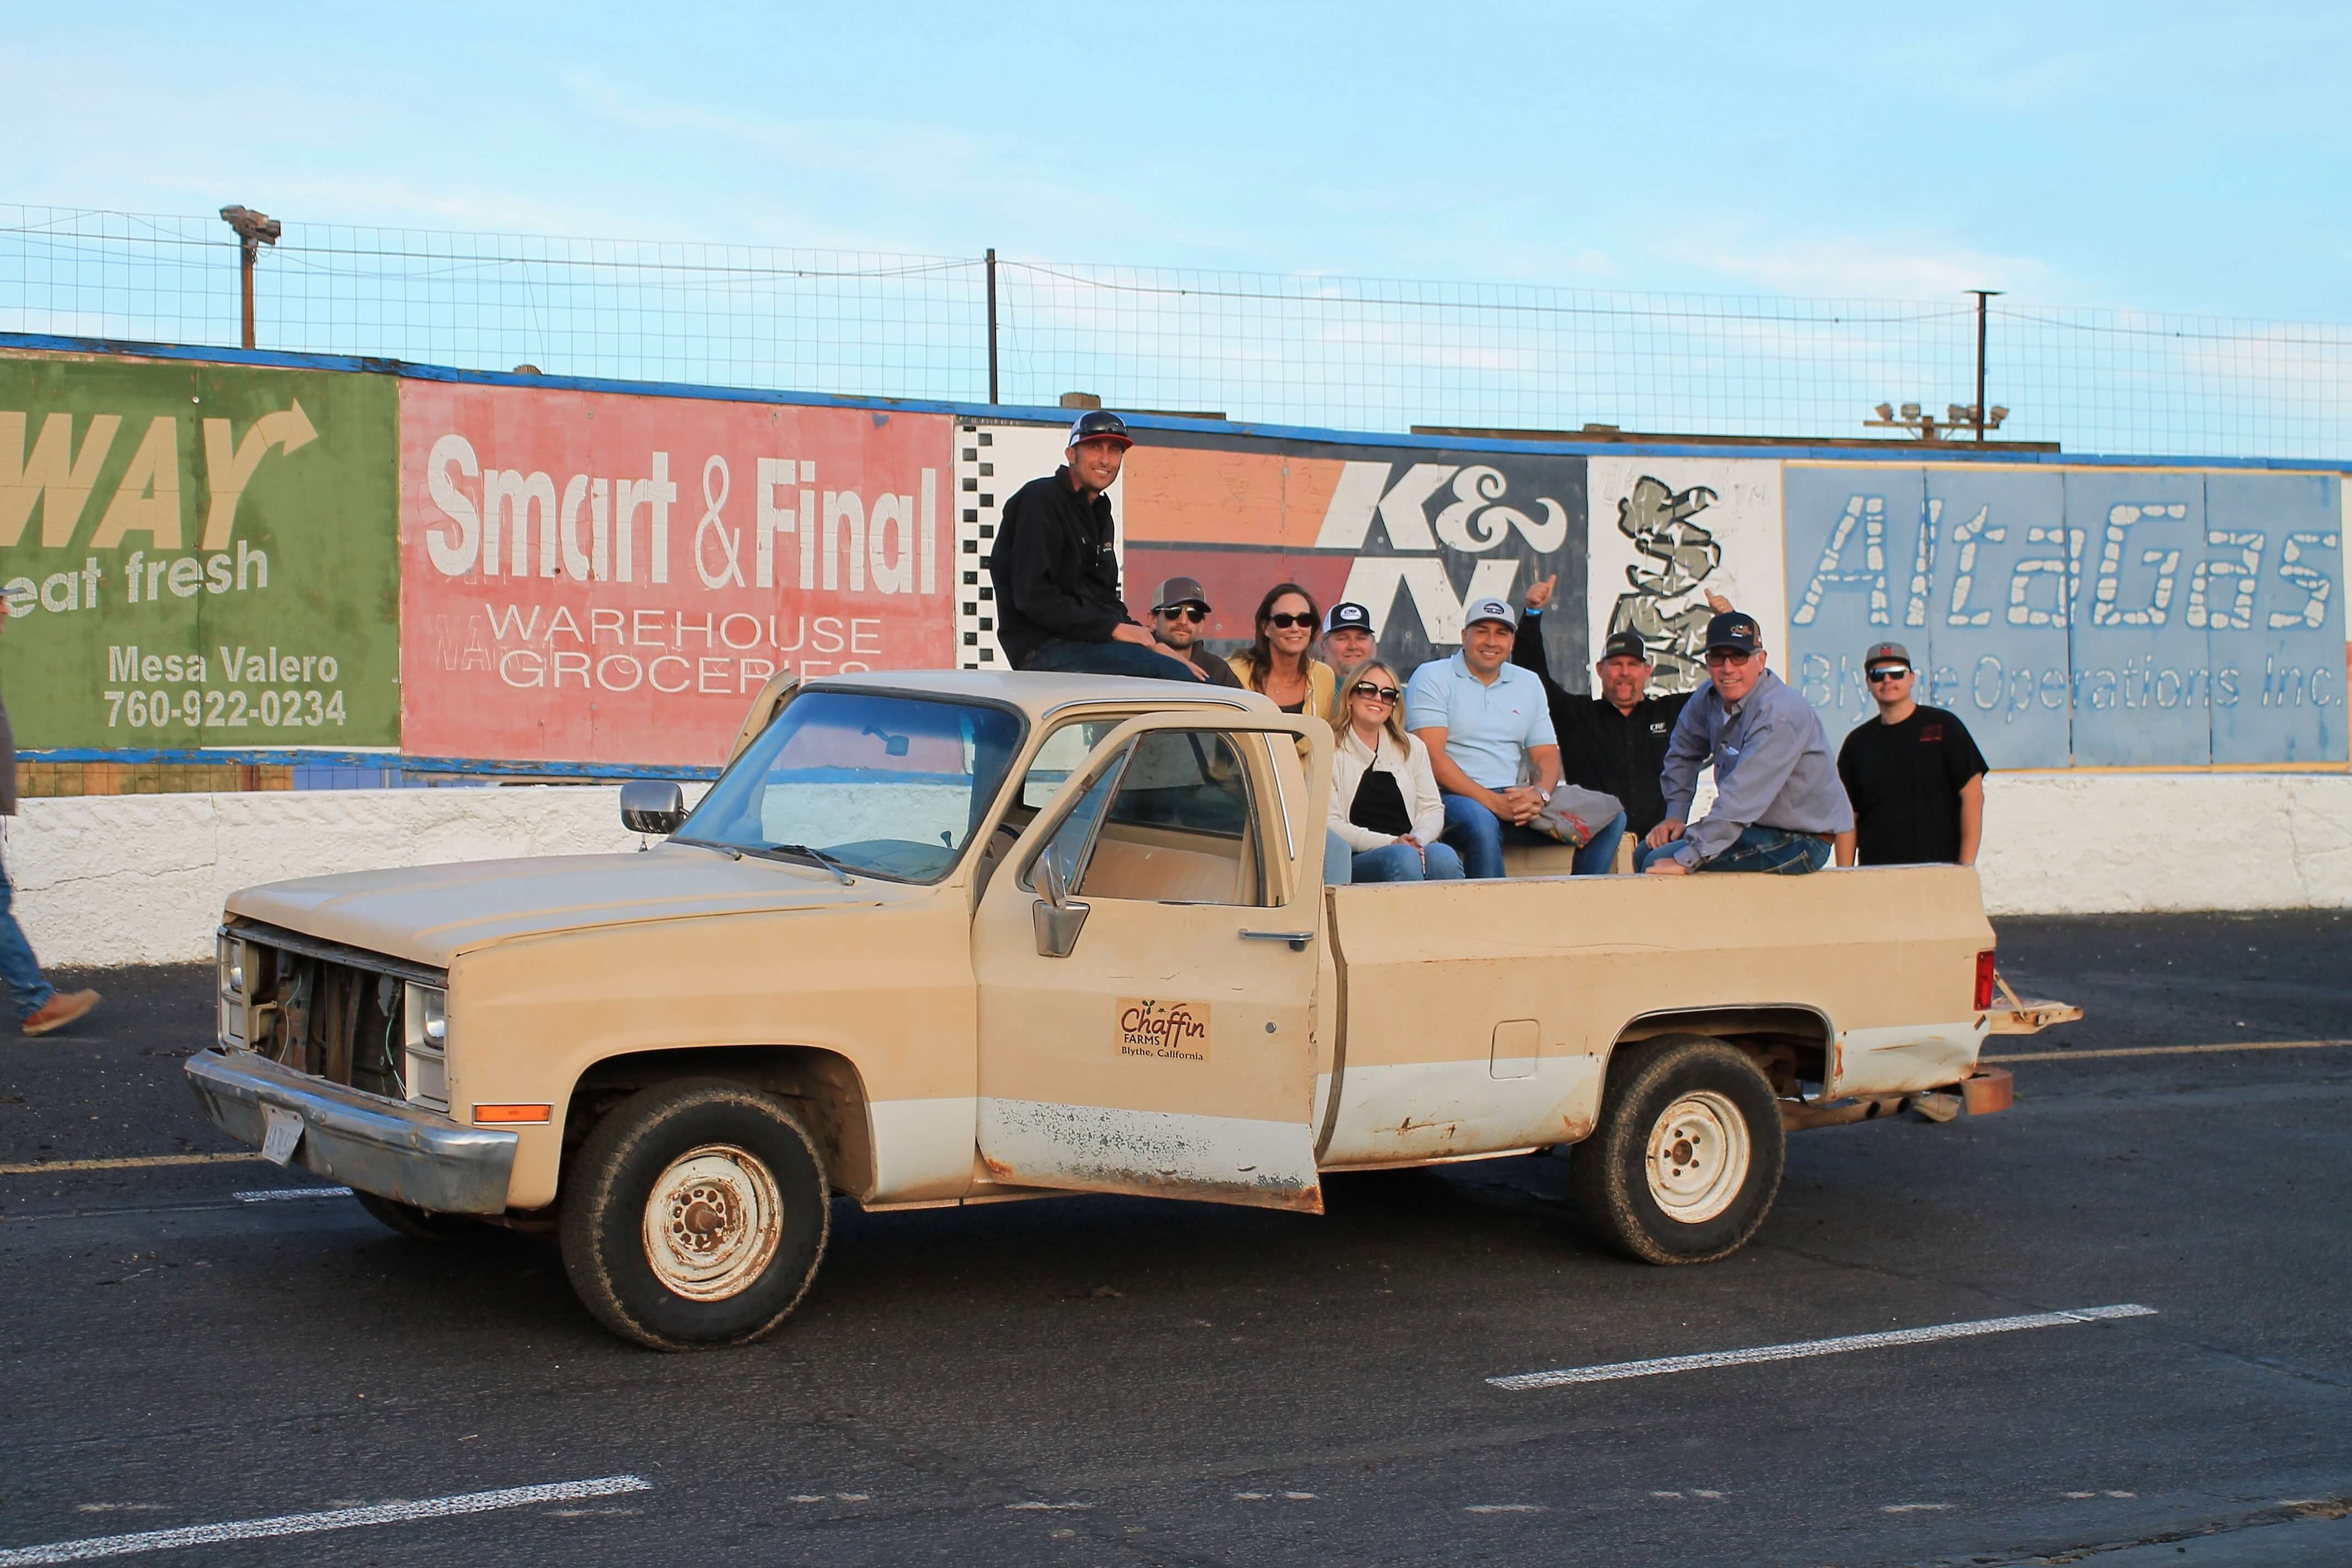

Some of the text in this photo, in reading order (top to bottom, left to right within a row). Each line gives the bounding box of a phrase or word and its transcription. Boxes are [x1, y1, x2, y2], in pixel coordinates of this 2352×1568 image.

[426, 434, 938, 595] Smart & Final
[2, 540, 268, 618] eat fresh
[1792, 494, 2339, 630] AltaGas
[484, 603, 881, 655] WAREHOUSE
[108, 646, 339, 683] Mesa Valero
[499, 649, 870, 695] GROCERE
[104, 690, 347, 728] 760-922-0234
[1973, 653, 2241, 725] Operations
[2261, 654, 2343, 708] Inc.
[1120, 1003, 1205, 1047] Chaffin
[1124, 1033, 1160, 1046] FARMS
[1121, 1046, 1204, 1060] Blythe, California
